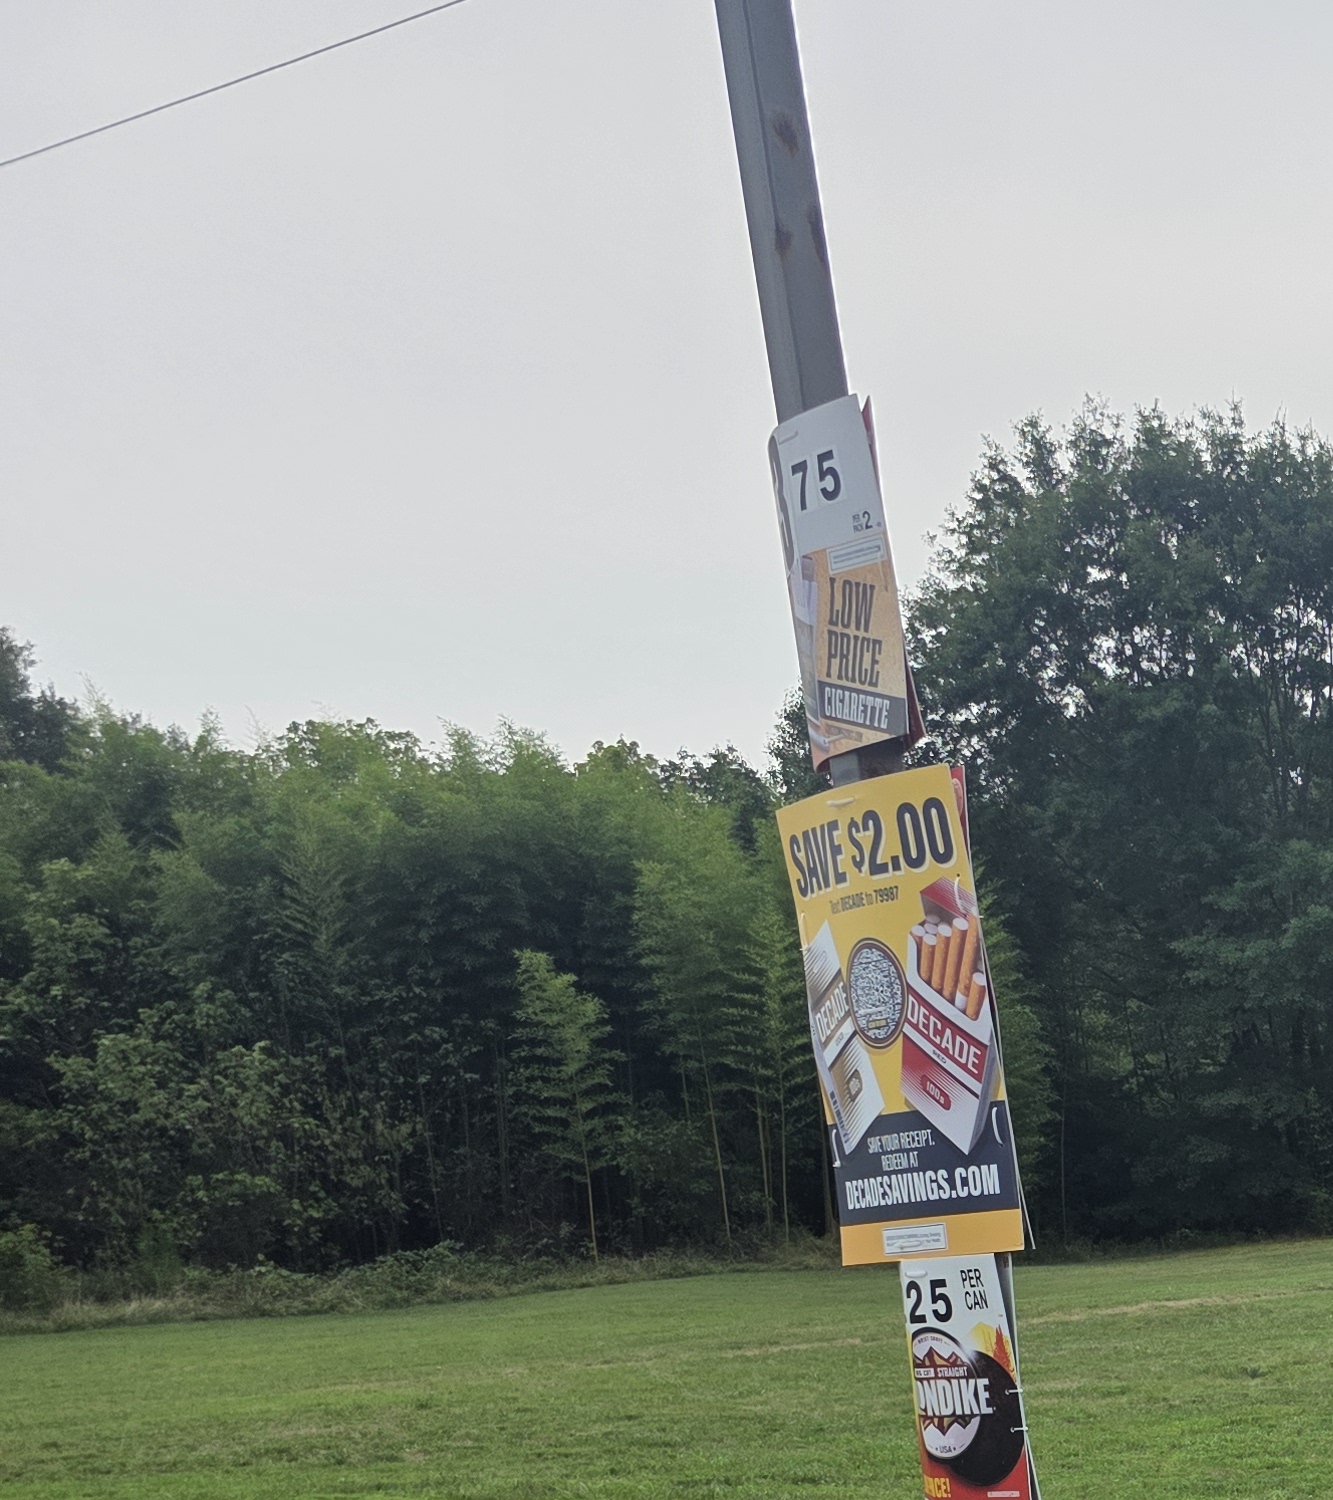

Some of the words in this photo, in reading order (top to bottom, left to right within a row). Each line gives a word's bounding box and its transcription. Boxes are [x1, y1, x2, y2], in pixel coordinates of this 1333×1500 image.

[791, 449, 841, 511] 75
[829, 577, 875, 633] LOW
[826, 629, 882, 688] PRICE
[824, 686, 890, 729] CIGARETTE
[789, 819, 847, 898] SAVE
[848, 797, 954, 876] $2.00
[874, 886, 899, 904] 79987
[815, 981, 849, 1043] DECADE
[907, 994, 981, 1074] DECADE
[867, 1136, 882, 1153] SAVE
[881, 1133, 900, 1151] YOUR
[899, 1129, 935, 1149] RECEIPT.
[881, 1153, 909, 1171] REDEEM
[909, 1151, 919, 1168] AT
[845, 1163, 1001, 1210] DECADESAVINGS.COM
[960, 1268, 984, 1289] PER
[964, 1289, 988, 1310] CAN
[906, 1279, 953, 1324] 25
[937, 1366, 968, 1378] STRAIGHT
[939, 1445, 952, 1454] USA
